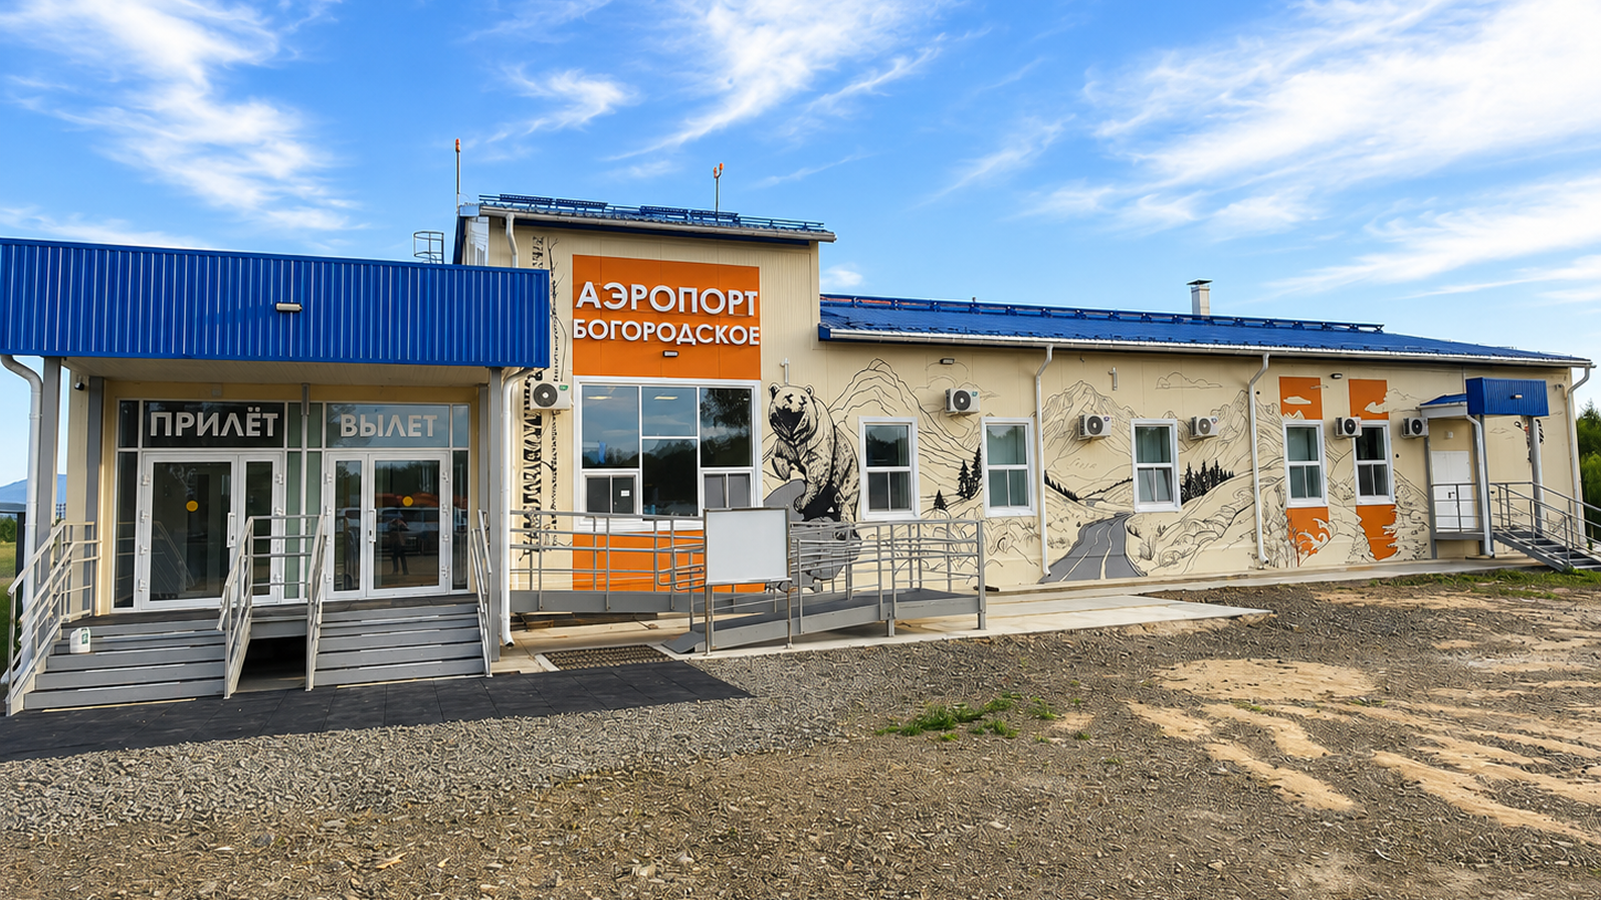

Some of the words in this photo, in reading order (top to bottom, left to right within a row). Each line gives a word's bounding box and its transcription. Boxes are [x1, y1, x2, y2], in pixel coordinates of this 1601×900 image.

[576, 281, 758, 316] АЭРОПОРТ
[573, 319, 760, 346] БОГОРОДСКОЕ
[150, 407, 279, 437] ПРИЛЁТ
[341, 414, 438, 437] ВЫЛЕТ
